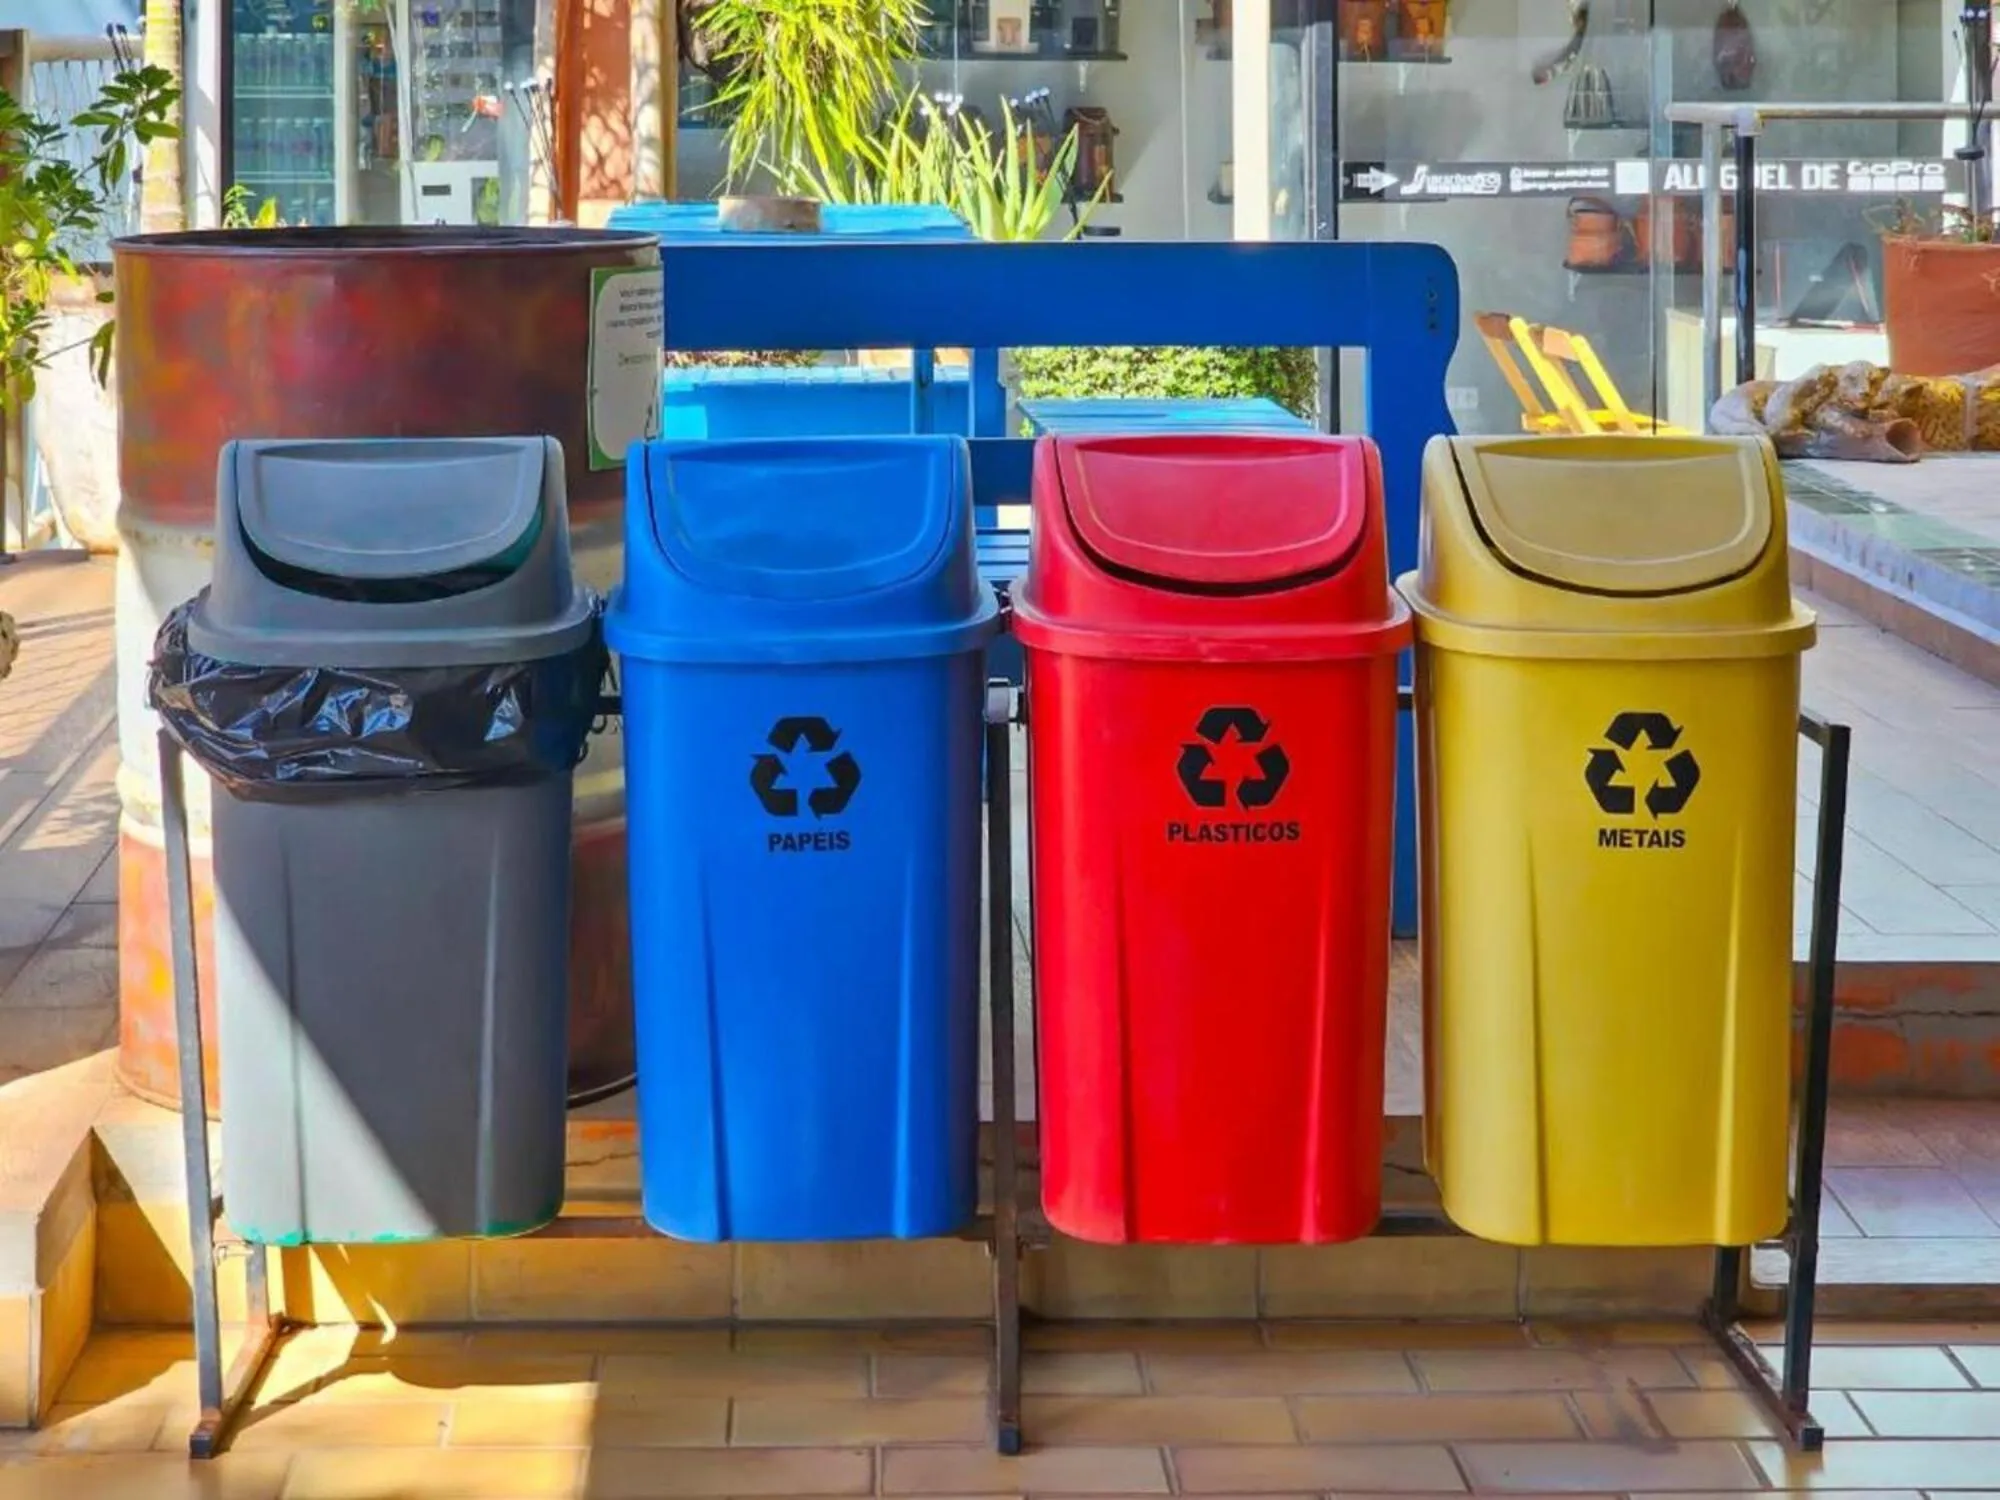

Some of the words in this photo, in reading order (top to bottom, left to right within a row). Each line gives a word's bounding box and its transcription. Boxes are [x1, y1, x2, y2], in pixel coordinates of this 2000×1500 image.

[1664, 162, 1794, 191] ALGEL
[1801, 163, 1841, 191] DE
[1847, 161, 1945, 176] GoPro
[1598, 828, 1687, 849] METAIS
